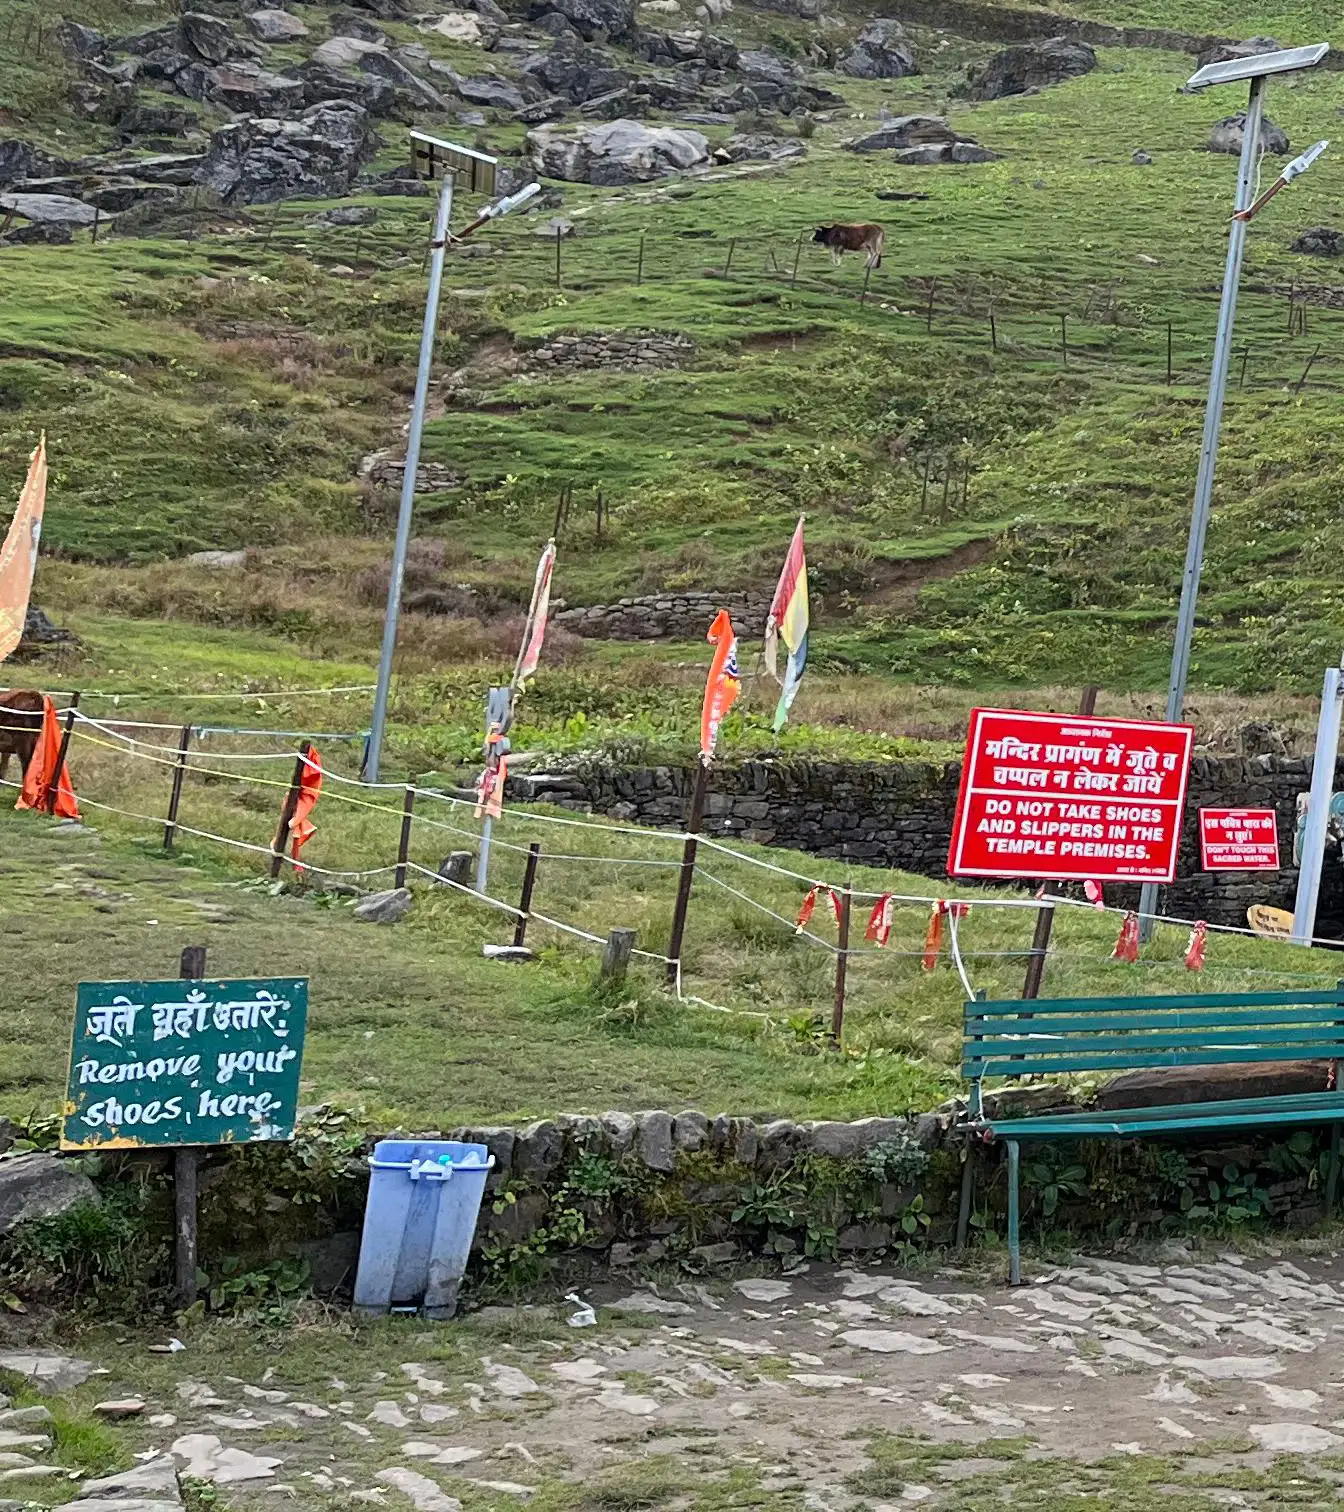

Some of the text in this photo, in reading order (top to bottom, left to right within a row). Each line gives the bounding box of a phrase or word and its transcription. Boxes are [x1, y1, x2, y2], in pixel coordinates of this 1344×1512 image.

[985, 736, 1042, 761] मन्दिर
[1105, 743, 1125, 767] में
[1126, 746, 1159, 776] जूते
[1163, 752, 1179, 771] व
[993, 766, 1050, 788] चप्पल
[1053, 769, 1070, 789] न
[1073, 766, 1120, 792] लेकर
[985, 799, 1162, 823] DO NOT TAKE SHOES
[977, 819, 1165, 842] AND SLIPPERS IN THE
[985, 838, 1151, 860] TEMPLE PREMISES.
[87, 995, 144, 1048] जूते
[76, 1045, 296, 1085] Remove your
[197, 1089, 281, 1117] here
